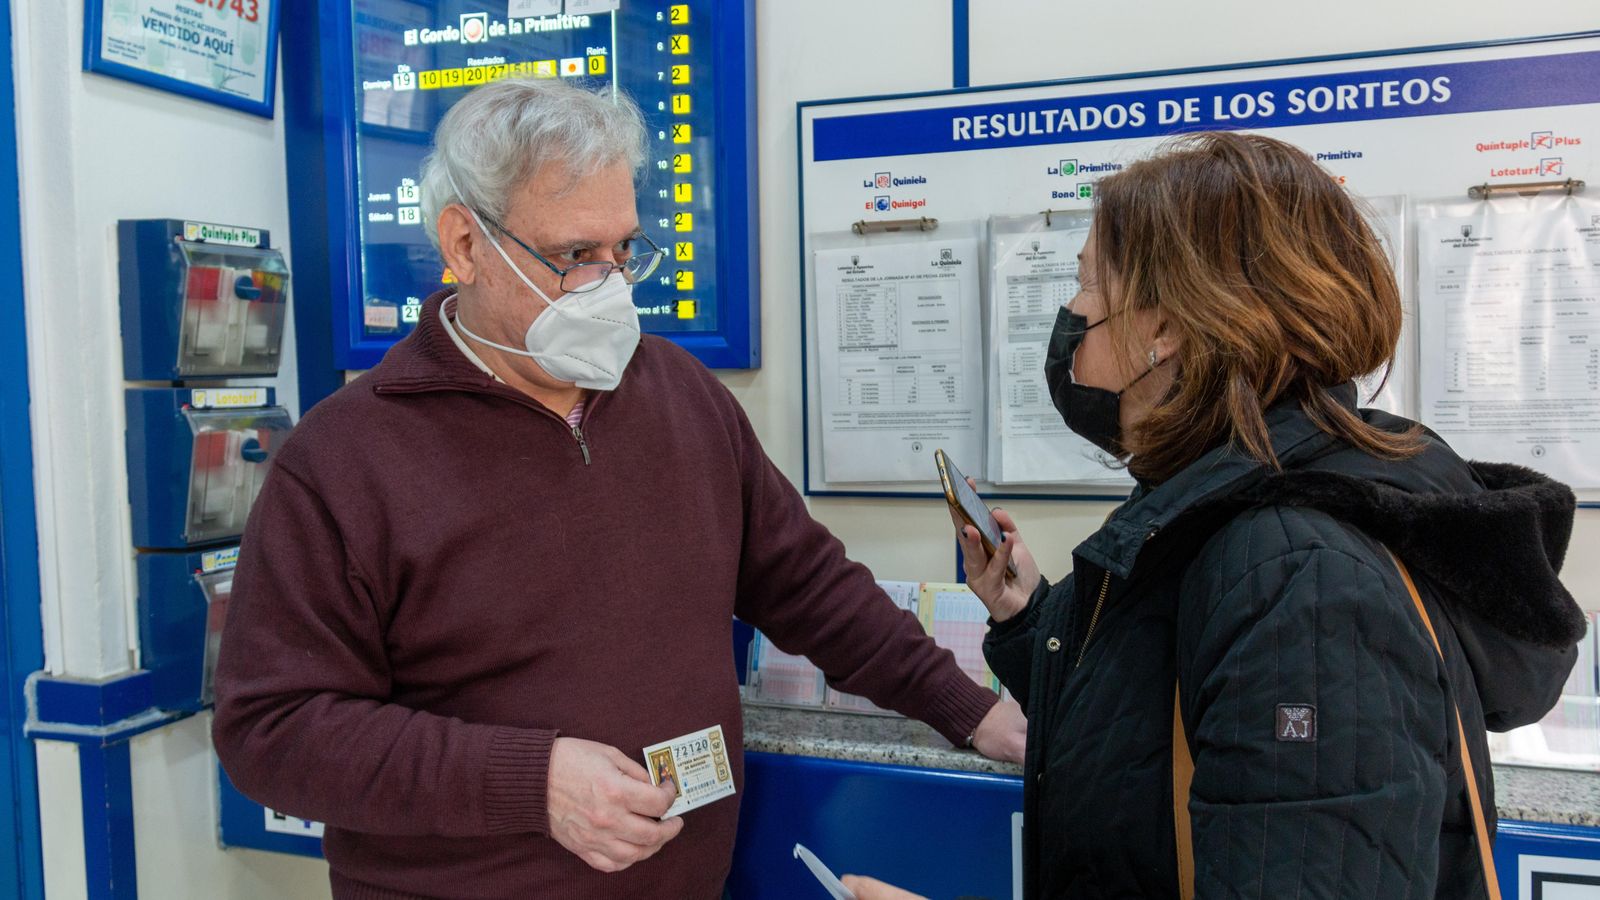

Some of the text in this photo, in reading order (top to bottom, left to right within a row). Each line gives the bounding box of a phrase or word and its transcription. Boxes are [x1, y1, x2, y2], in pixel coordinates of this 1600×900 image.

[656, 8, 680, 21] 5 2
[141, 15, 200, 45] VENDIDO
[204, 36, 234, 56] AQUÍ
[404, 14, 591, 46] El Gordo de la Primitiva
[671, 36, 681, 50] X
[467, 55, 505, 67] Resultados
[397, 73, 411, 86] 19
[423, 72, 437, 85] 10
[445, 70, 459, 83] 19
[467, 68, 483, 81] 20
[490, 66, 505, 79] 27
[591, 58, 599, 71] 0
[657, 67, 681, 81] 7 2
[953, 76, 1452, 141] RESULTADOS DE LOS SORTEOS
[672, 125, 682, 138] X
[1475, 136, 1582, 153] Quintuple Plus
[657, 154, 682, 170] 10 2
[1316, 150, 1364, 162] Primitiva
[1047, 161, 1123, 176] La Primitiva
[1490, 167, 1540, 178] Lototurf
[863, 175, 928, 189] La Quiniela
[400, 187, 414, 198] 16
[659, 189, 668, 198] 11
[1051, 190, 1075, 200] Bono
[865, 198, 927, 210] El Quinigol
[400, 209, 415, 221] 18
[659, 212, 683, 228] 12 2
[201, 224, 257, 244] Quintuple Plus
[678, 243, 687, 257] X
[660, 269, 684, 286] 14 2
[405, 306, 420, 318] 21
[652, 305, 660, 315] al
[661, 304, 671, 315] 15
[674, 739, 708, 757] 72120
